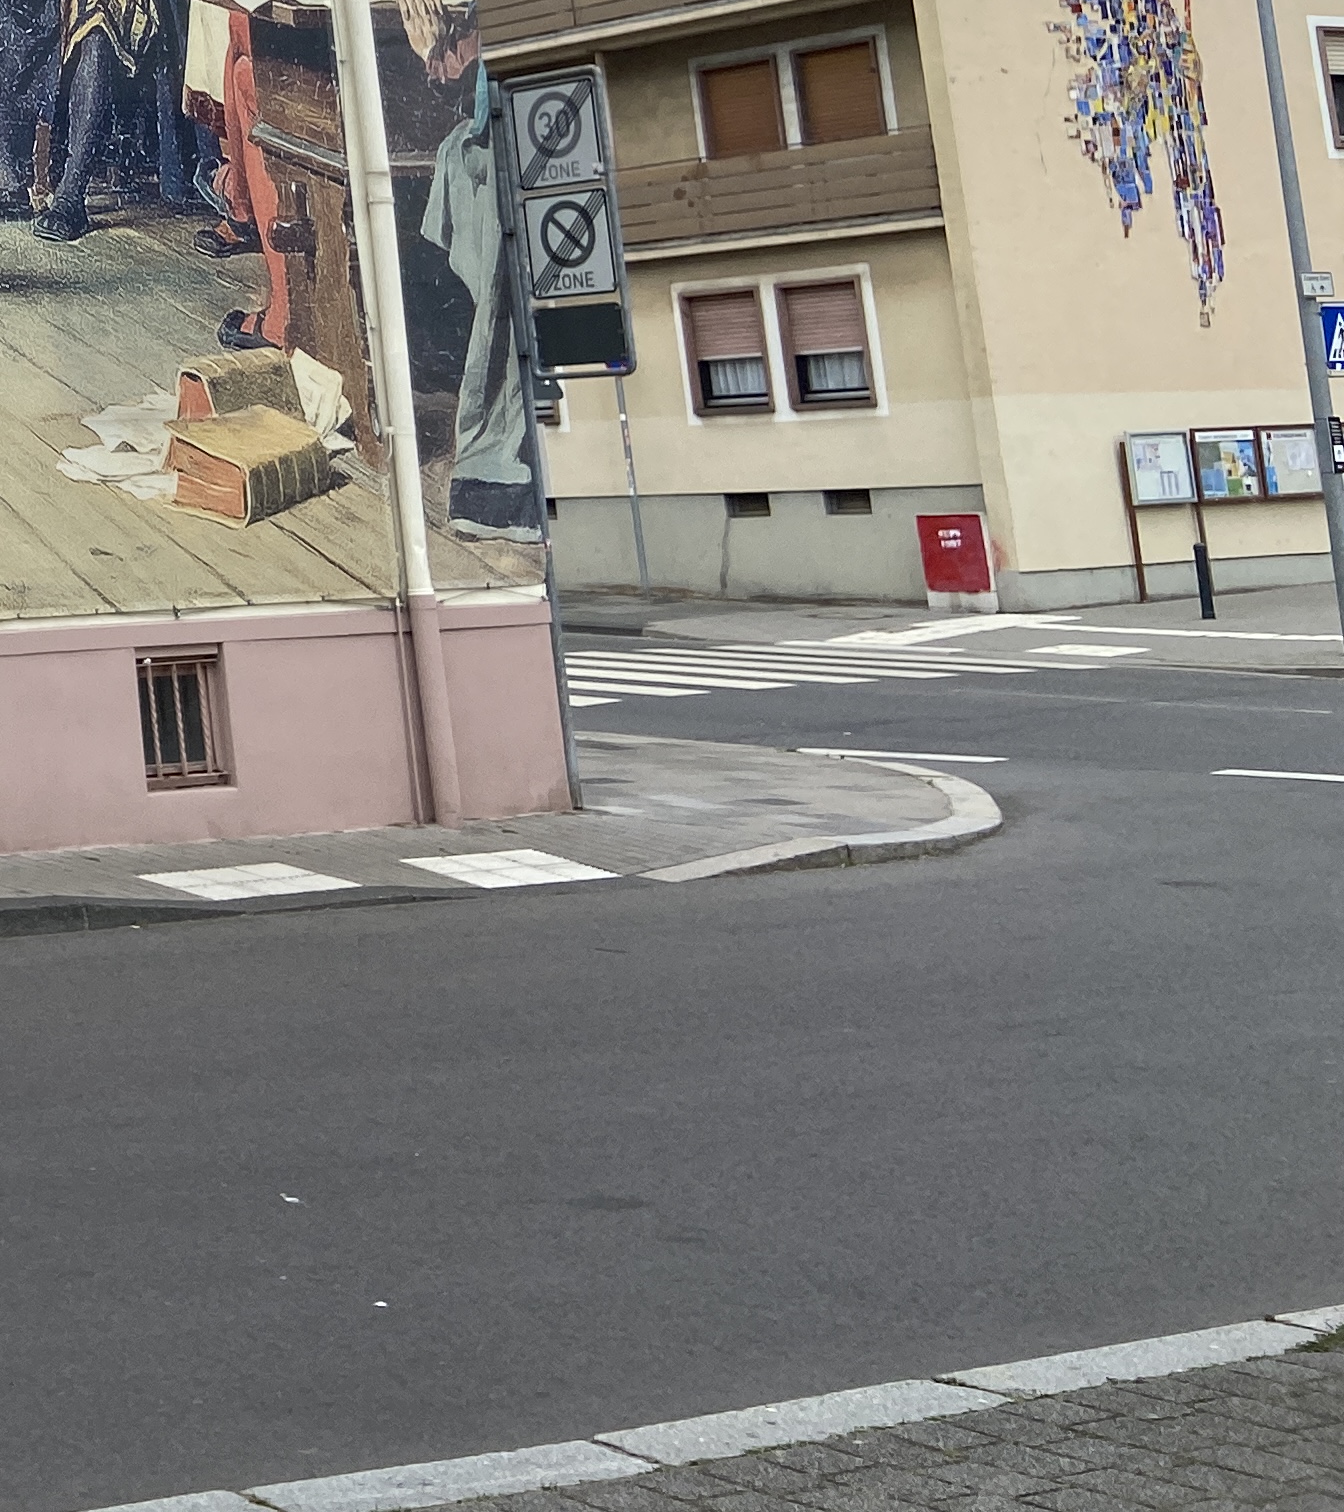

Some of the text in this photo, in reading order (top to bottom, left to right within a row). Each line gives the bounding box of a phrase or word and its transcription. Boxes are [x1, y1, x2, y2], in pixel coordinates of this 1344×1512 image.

[538, 109, 570, 141] 30
[539, 160, 580, 181] ZONE
[552, 271, 595, 291] ZONE
